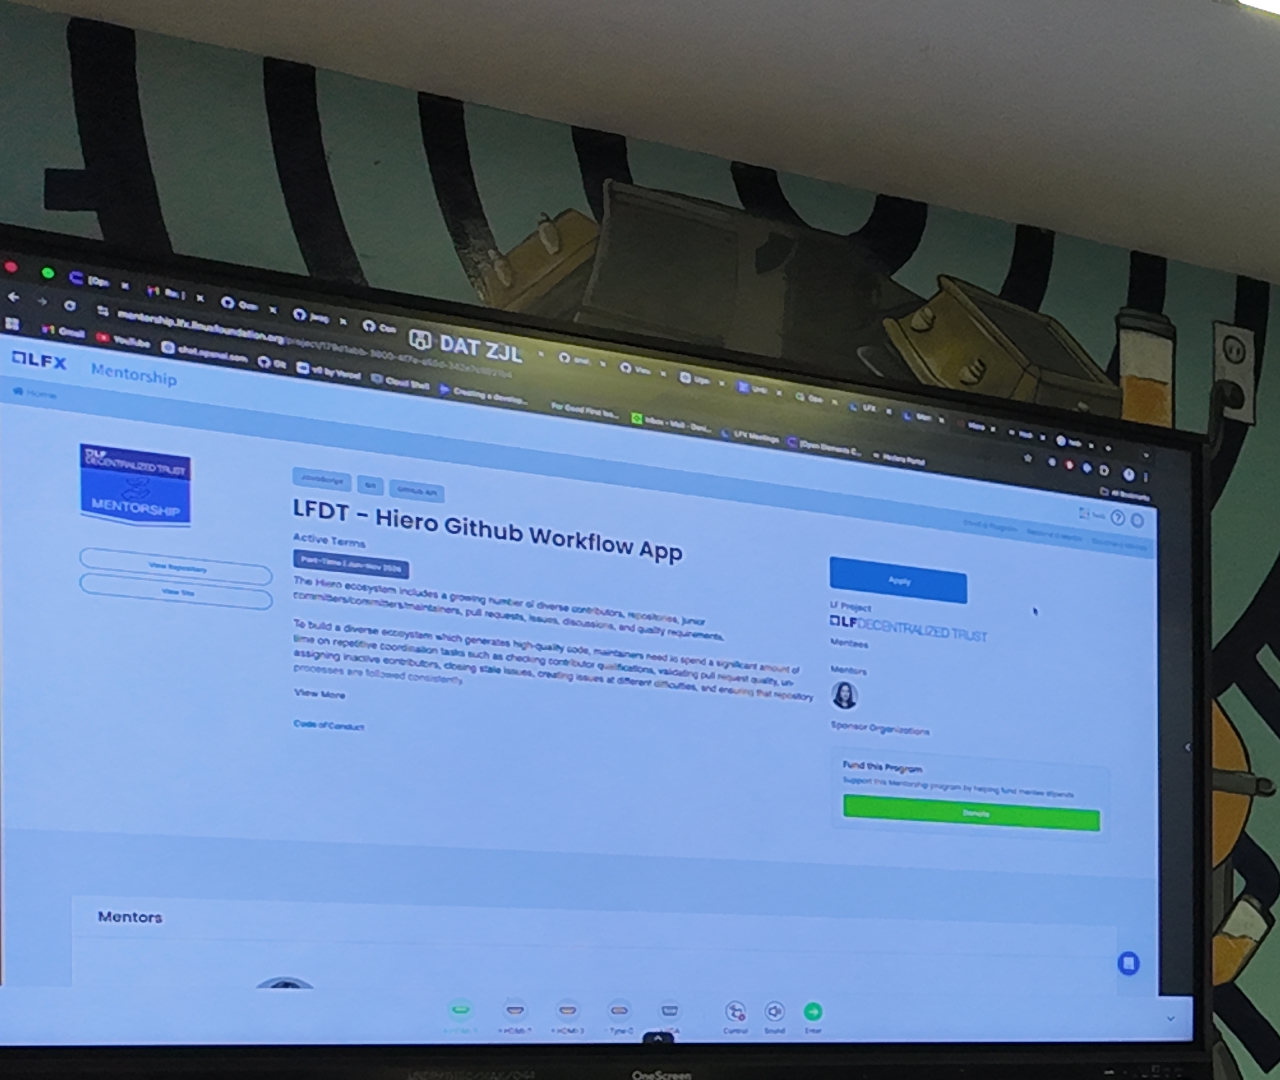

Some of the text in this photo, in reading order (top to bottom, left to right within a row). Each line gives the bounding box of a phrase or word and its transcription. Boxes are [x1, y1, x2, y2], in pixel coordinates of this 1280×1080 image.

[58, 326, 86, 340] Gmail
[113, 335, 151, 349] YouTube
[440, 334, 523, 364] DAT ZJL
[91, 362, 178, 389] Mentorship
[85, 457, 186, 476] DECENTRALIZED TRUST
[92, 497, 181, 518] MENTORSHIP
[293, 498, 683, 566] LFDT Hiero Github Workflow App
[293, 531, 367, 549] Active Terms
[888, 575, 912, 588] Apply
[293, 576, 313, 587] The
[315, 578, 342, 589] Hiero
[345, 581, 397, 597] ecosystem
[399, 586, 439, 600] includes
[450, 592, 486, 606] growing
[488, 595, 523, 608] number
[536, 601, 569, 613] diverse
[840, 601, 872, 613] Project
[618, 621, 636, 633] and
[293, 618, 306, 629] To
[308, 620, 332, 632] build
[343, 624, 379, 636] diverse
[381, 628, 433, 642] ecosystem
[435, 632, 463, 644] which
[593, 647, 644, 661] maintainers
[646, 651, 668, 663] need
[680, 655, 707, 667] spend
[951, 627, 988, 643] TRUST
[830, 637, 869, 649] Mentees
[293, 649, 341, 663] assigning
[467, 650, 490, 661] such
[293, 663, 345, 676] processes
[365, 668, 406, 681] followed
[830, 665, 868, 677] Mentors
[293, 688, 346, 700] View More
[831, 720, 931, 737] Sponsor Organizations
[843, 760, 924, 775] Fund this Program
[962, 808, 991, 819] Donate
[97, 910, 165, 926] Mentors
